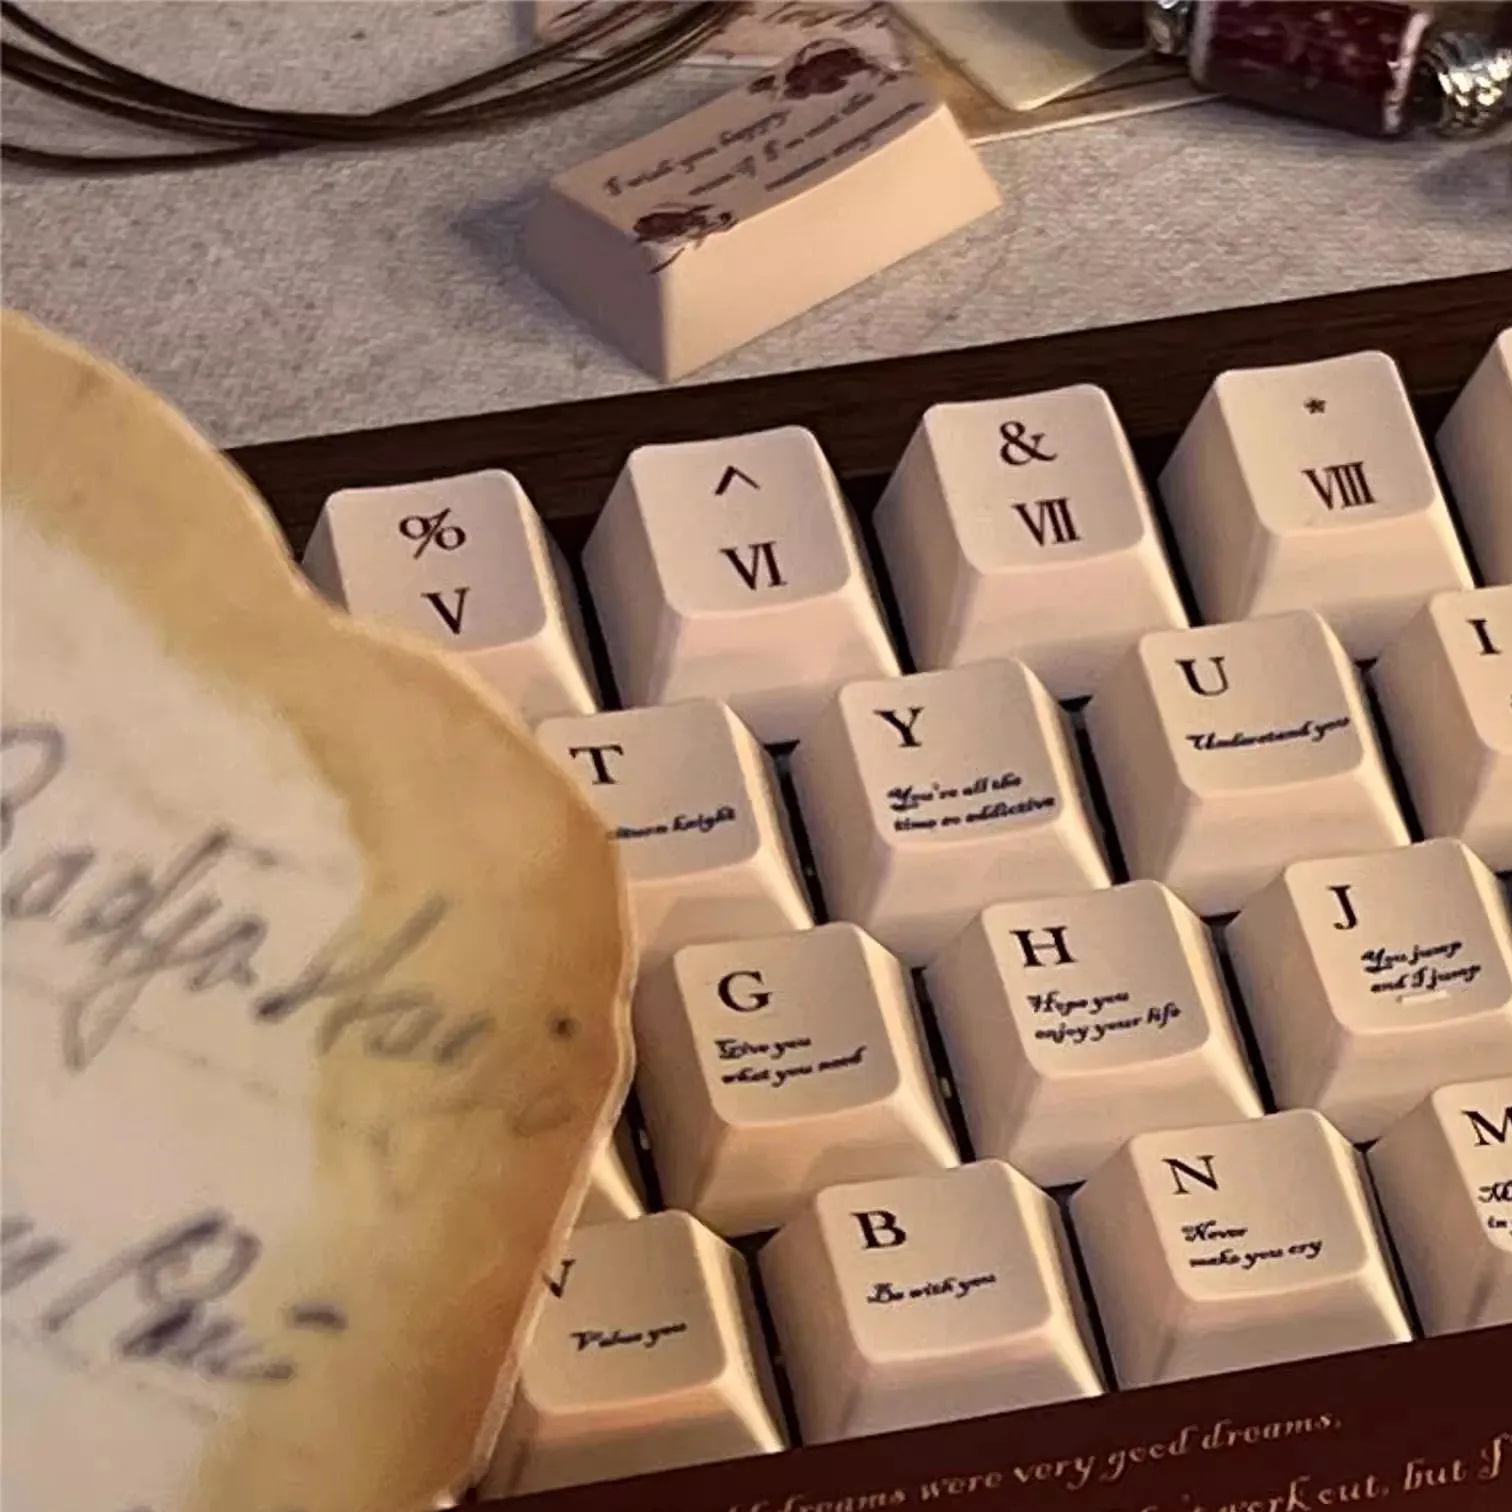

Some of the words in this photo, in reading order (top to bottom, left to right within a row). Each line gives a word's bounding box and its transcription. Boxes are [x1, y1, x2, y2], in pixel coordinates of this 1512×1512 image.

[1000, 420, 1057, 465] &
[1302, 461, 1377, 510] VIII
[400, 508, 466, 559] %
[1012, 498, 1081, 547] VII
[720, 541, 788, 591] VI
[422, 588, 470, 634] V
[1467, 619, 1502, 656] I
[1176, 656, 1229, 697] U
[874, 707, 924, 748] Y
[1185, 721, 1313, 751] Understand
[1311, 716, 1350, 743] you
[569, 744, 624, 785] T
[1327, 884, 1359, 931] J
[1009, 925, 1078, 968] H
[1360, 948, 1407, 973] You
[1407, 940, 1463, 967] jump
[717, 969, 773, 1013] G
[1370, 973, 1408, 994] and
[1428, 961, 1482, 988] jump
[1025, 992, 1087, 1016] Hope
[1088, 990, 1130, 1014] you
[1034, 1021, 1092, 1043] enjoy
[1092, 1017, 1142, 1041] your
[1145, 1002, 1182, 1027] life
[714, 1039, 770, 1061] Give
[771, 1037, 812, 1060] you
[721, 1066, 770, 1086] what
[771, 1066, 813, 1088] you
[817, 1045, 868, 1073] need
[1162, 1154, 1220, 1195] N
[851, 1209, 908, 1249] B
[1181, 1219, 1248, 1243] Never
[1189, 1248, 1242, 1269] make
[1242, 1246, 1285, 1271] you
[1287, 1240, 1324, 1264] cry
[866, 1283, 904, 1305] Be
[908, 1276, 957, 1300] with
[957, 1272, 997, 1299] you
[571, 1328, 644, 1351] Value
[644, 1322, 688, 1349] you
[918, 1469, 1003, 1501] were
[1012, 1452, 1096, 1491] very
[1101, 1424, 1199, 1481] good
[1402, 1456, 1469, 1494] but
